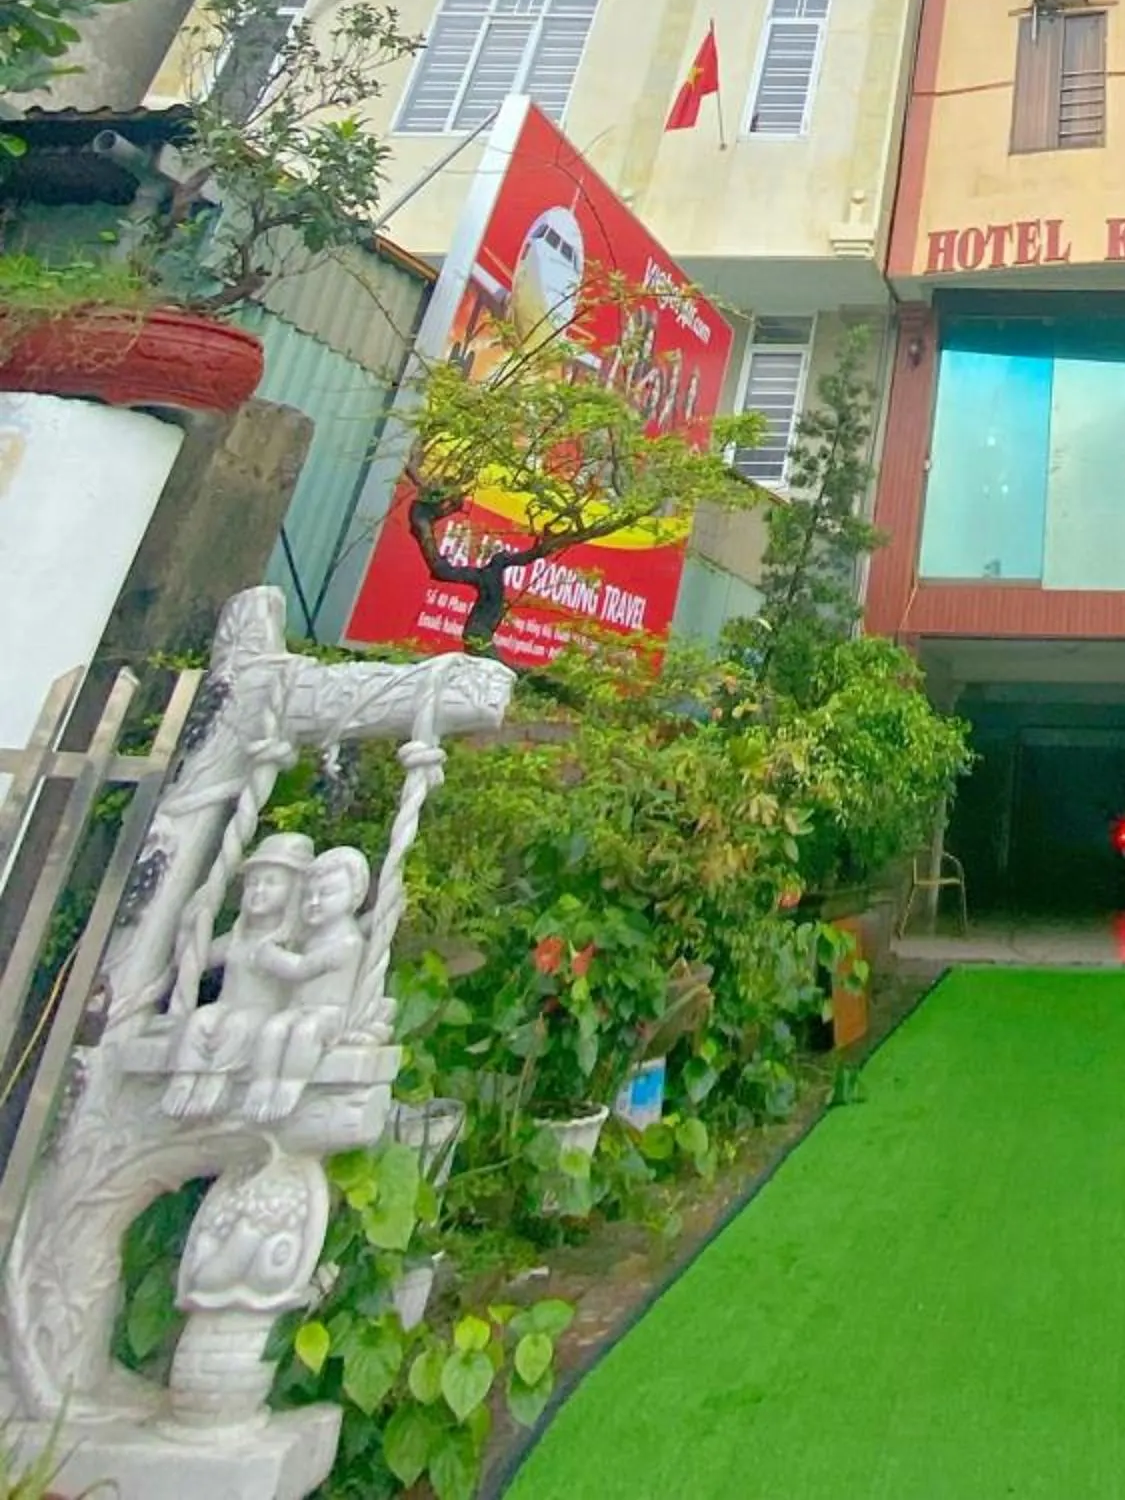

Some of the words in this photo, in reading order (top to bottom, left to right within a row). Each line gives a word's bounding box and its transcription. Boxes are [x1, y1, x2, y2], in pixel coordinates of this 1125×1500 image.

[924, 218, 1071, 273] HOTEL
[527, 557, 600, 616] BOOKING
[600, 584, 648, 629] TRAVEL
